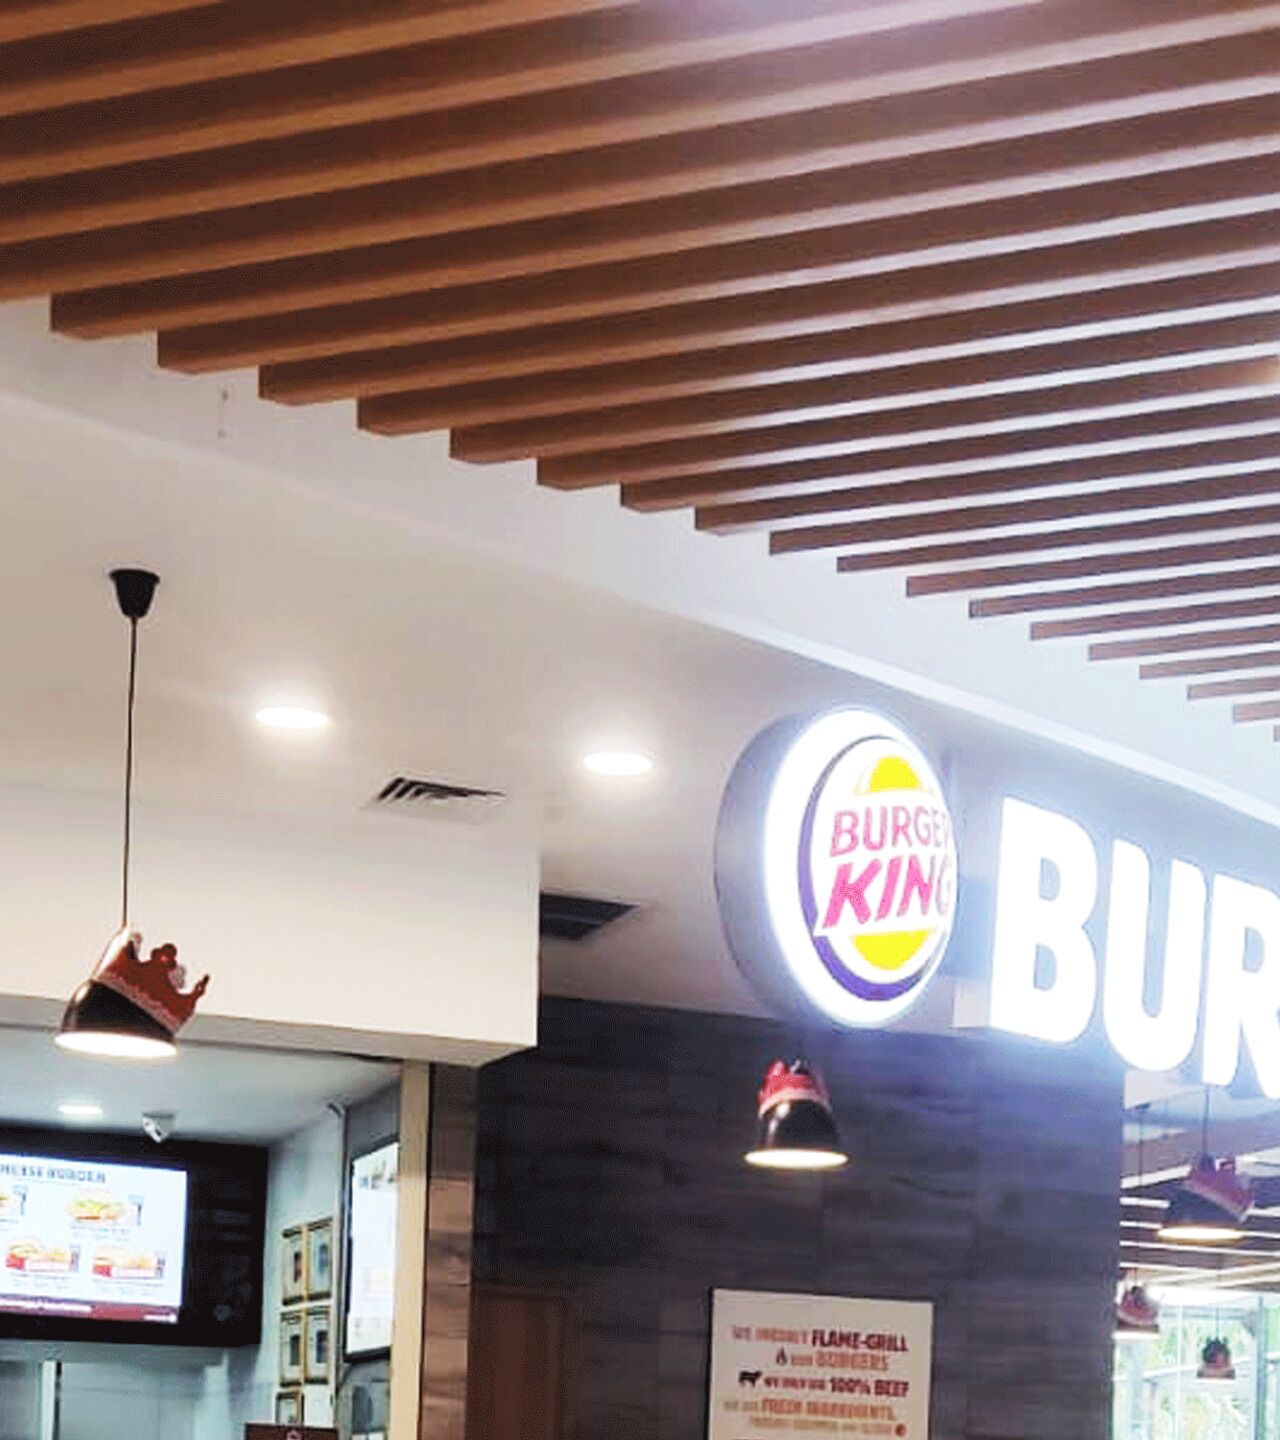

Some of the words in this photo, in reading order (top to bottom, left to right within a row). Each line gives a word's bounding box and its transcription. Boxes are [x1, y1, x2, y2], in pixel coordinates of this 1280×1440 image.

[811, 1330, 908, 1352] FLAME-GRILL
[830, 1378, 870, 1395] 100%
[875, 1380, 909, 1397] BEEF
